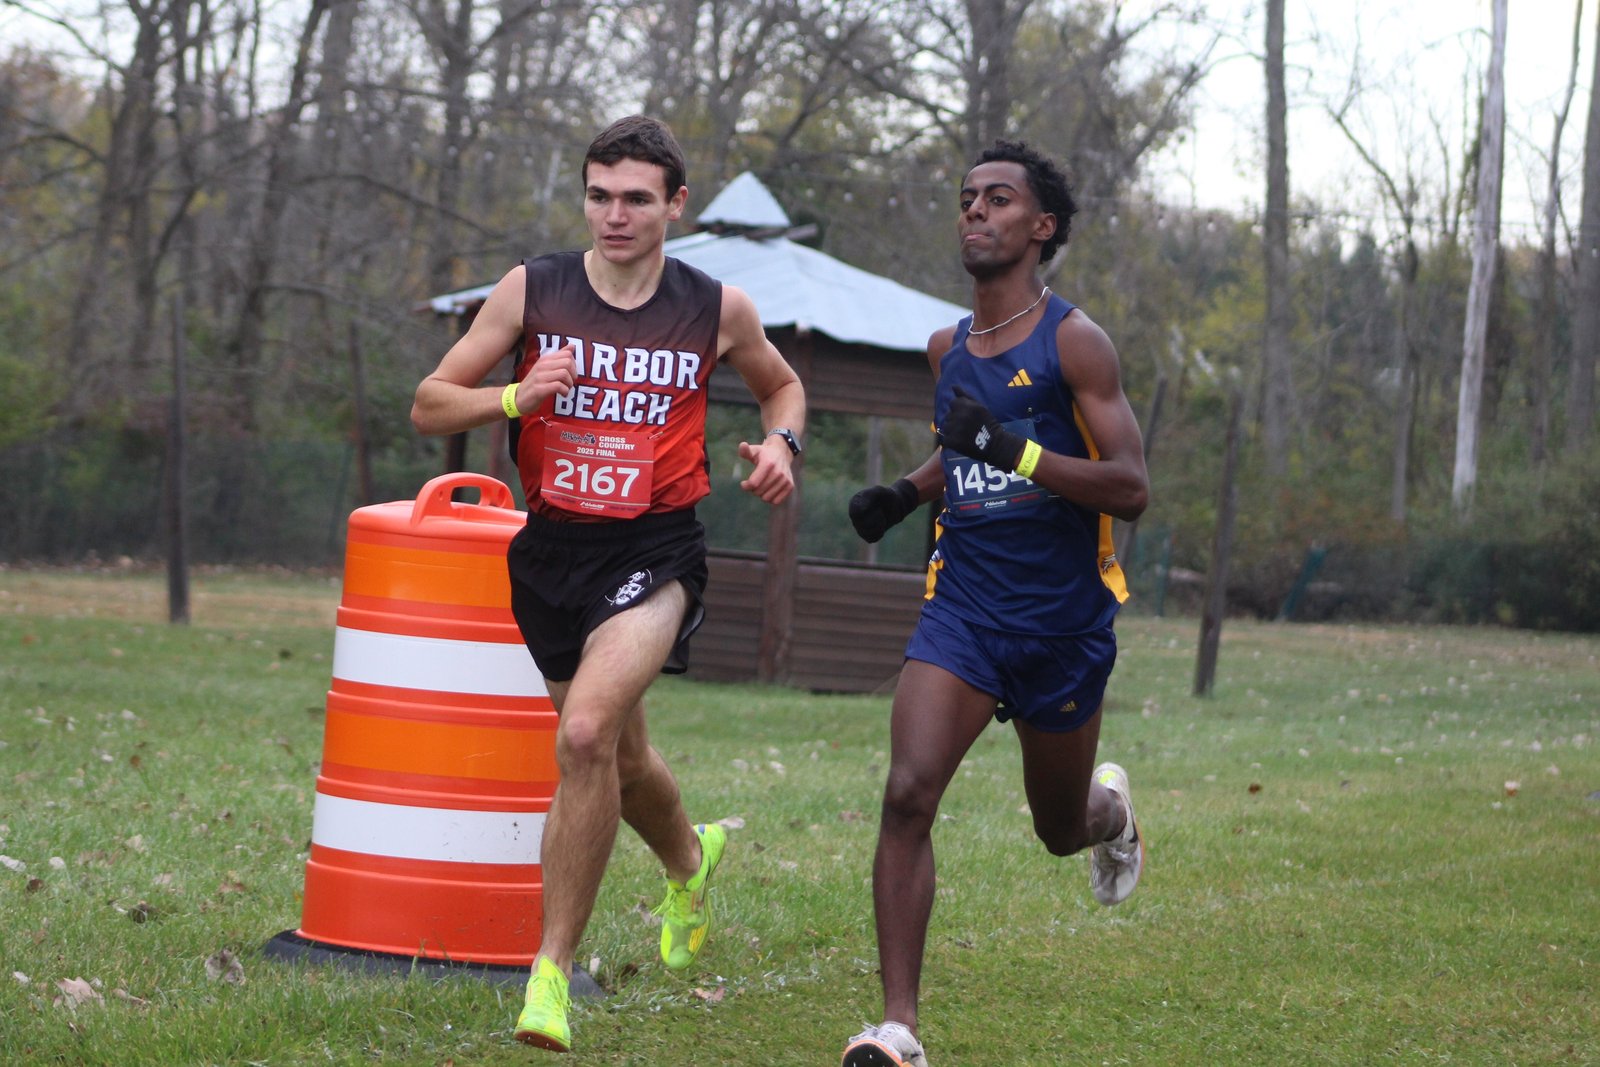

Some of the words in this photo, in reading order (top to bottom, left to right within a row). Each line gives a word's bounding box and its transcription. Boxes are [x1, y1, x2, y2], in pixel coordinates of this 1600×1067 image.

[537, 333, 701, 390] HARBOR
[553, 386, 672, 425] BEACH
[576, 447, 594, 455] 2025
[596, 449, 617, 457] FINAL
[598, 442, 635, 450] COUNTRY
[553, 458, 640, 497] 2167
